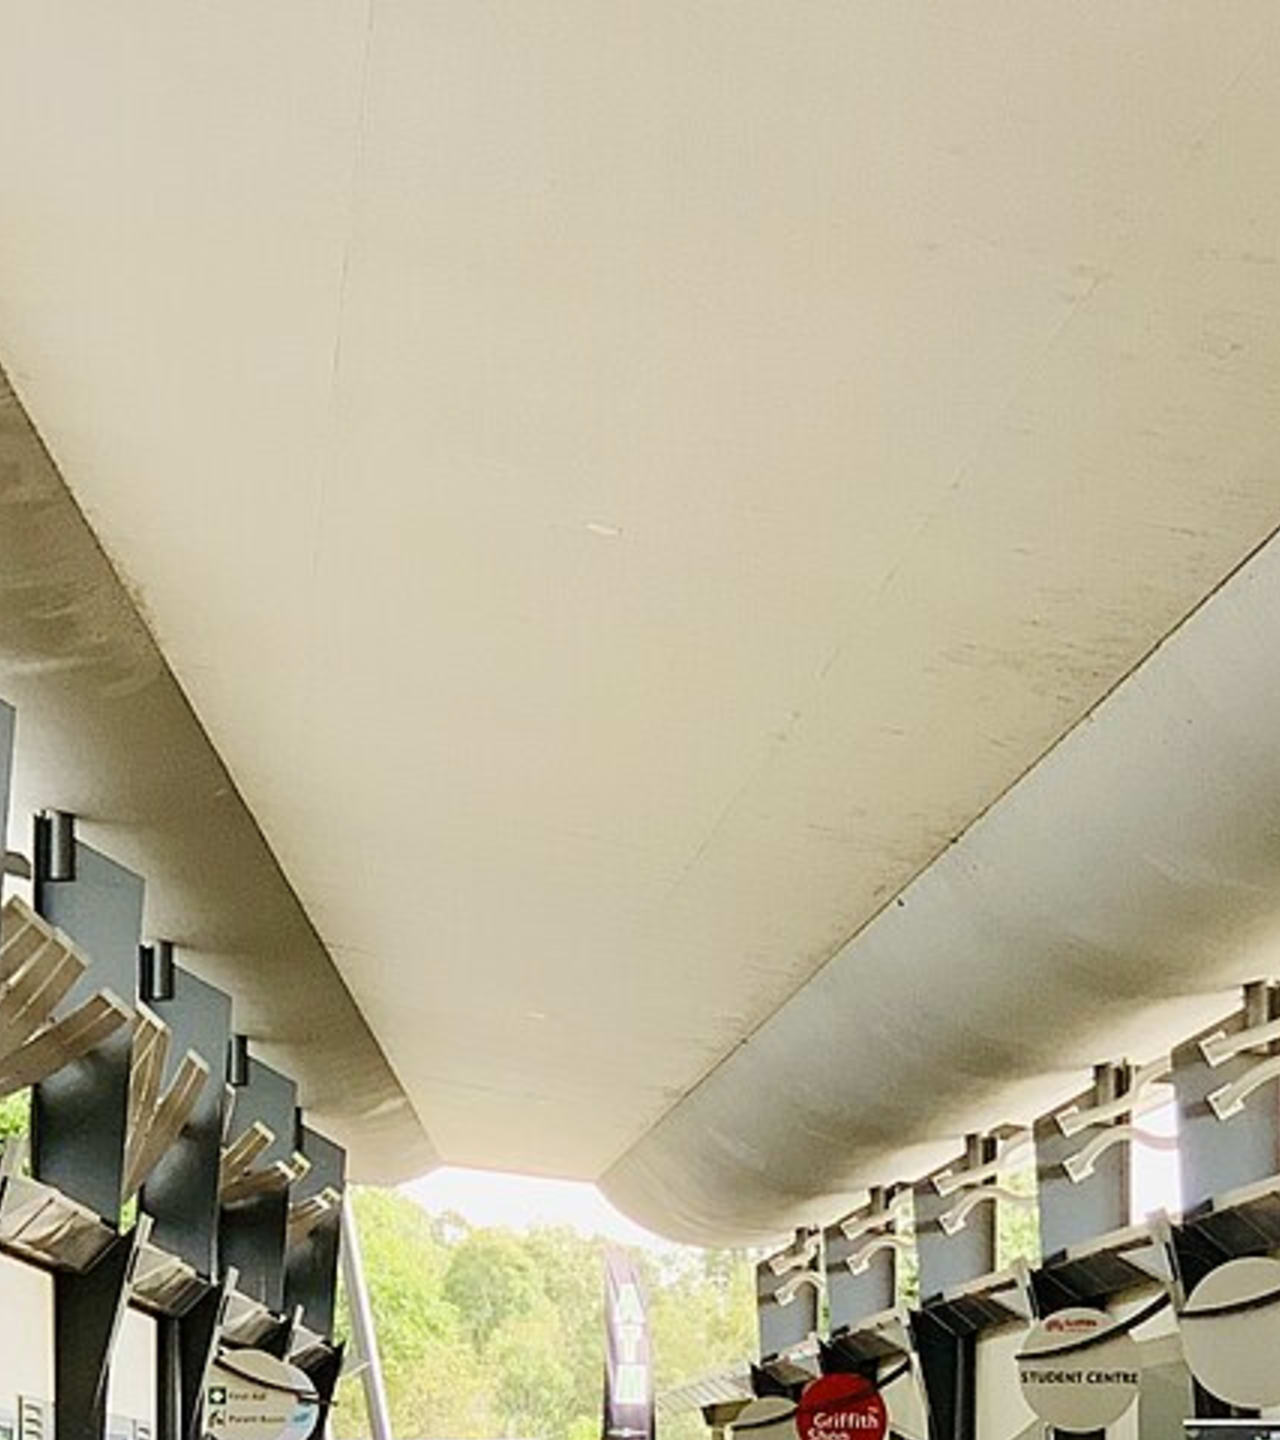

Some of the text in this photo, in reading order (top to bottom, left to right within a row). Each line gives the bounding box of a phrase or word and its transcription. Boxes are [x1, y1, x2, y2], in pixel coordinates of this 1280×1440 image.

[1021, 1371, 1138, 1383] STUDENT CENTRE
[813, 1412, 879, 1428] Griffith
